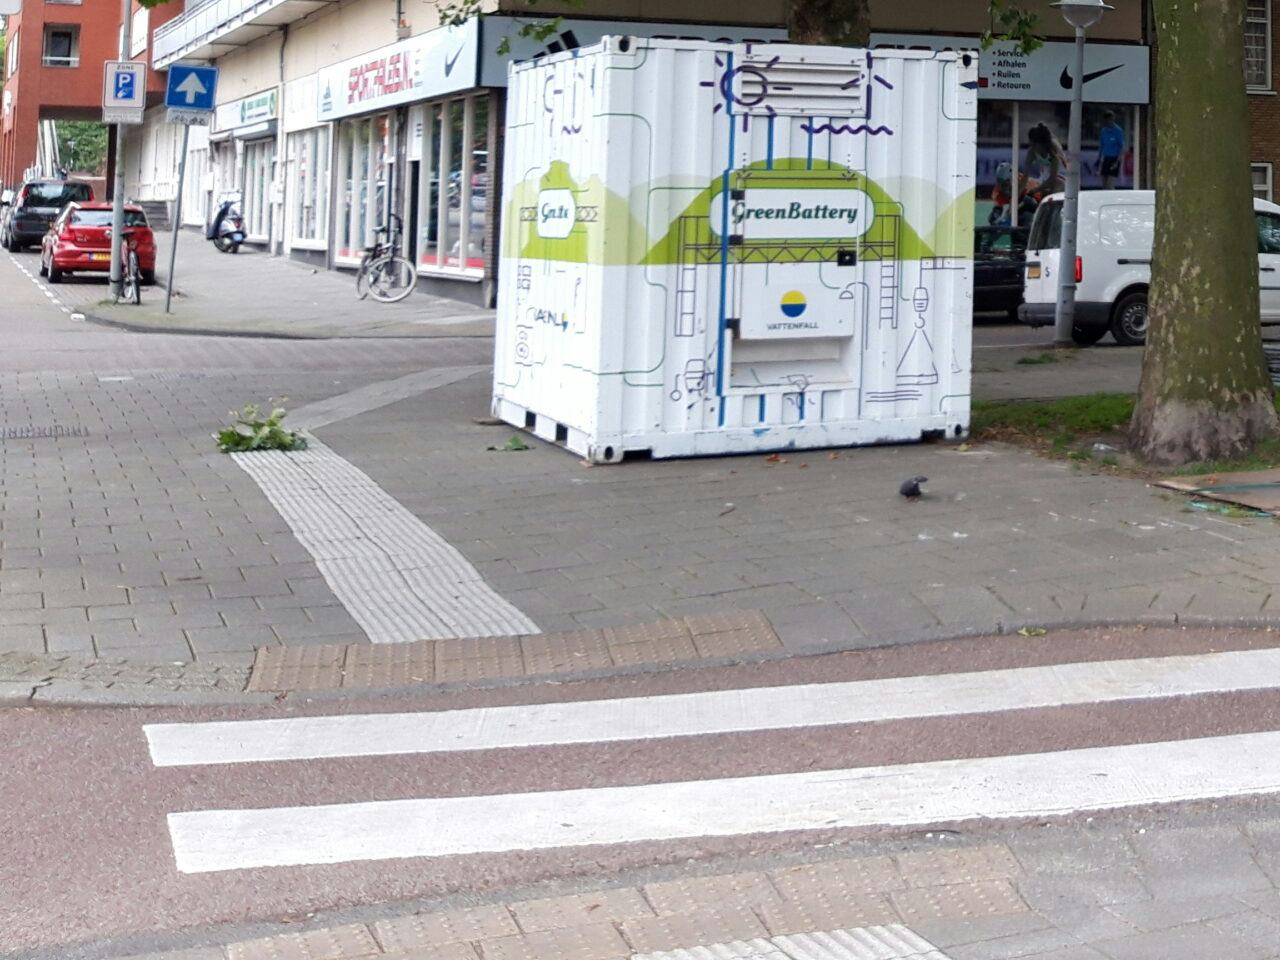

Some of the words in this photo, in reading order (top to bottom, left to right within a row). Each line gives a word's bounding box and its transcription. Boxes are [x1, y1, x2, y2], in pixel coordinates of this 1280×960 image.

[997, 49, 1024, 58] Service
[997, 60, 1027, 68] Afhalen
[997, 70, 1021, 79] Ruilen
[118, 73, 132, 88] P
[997, 81, 1031, 90] Retouren
[731, 201, 858, 224] GreenBattery
[766, 322, 820, 330] VATTENFALL
